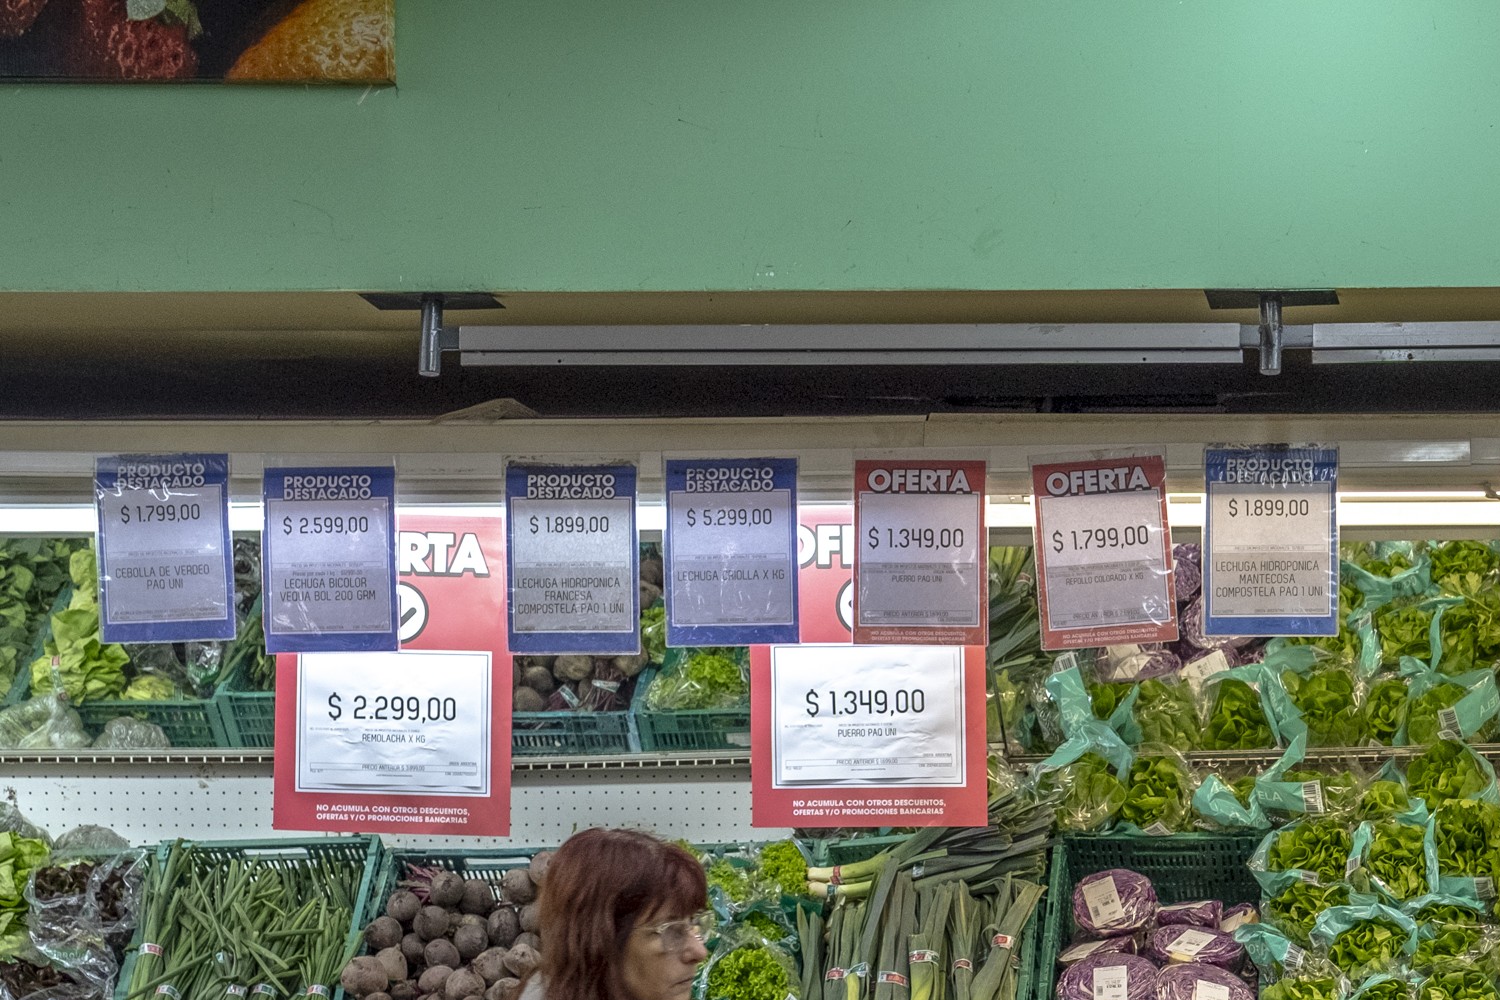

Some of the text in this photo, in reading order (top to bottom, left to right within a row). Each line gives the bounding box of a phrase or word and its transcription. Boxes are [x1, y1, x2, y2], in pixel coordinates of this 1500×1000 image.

[117, 463, 205, 477] PRODUCTO
[1226, 458, 1314, 471] PRODUCTO
[527, 474, 616, 488] PRODUCTO
[686, 467, 774, 481] PRODUCTO
[867, 468, 973, 494] OFERTA
[1226, 470, 1314, 484] DESTACADO
[117, 475, 205, 490] DESTACADO
[283, 475, 372, 489] PRODUCTO
[686, 479, 774, 493] DESTACADO
[1046, 466, 1152, 497] OFERTA
[283, 487, 372, 500] DESTACADO
[527, 486, 616, 500] DESTACADO
[120, 503, 200, 524] $ 1.799,00
[1228, 498, 1309, 518] $ 1.899,00
[530, 515, 609, 534] $ 1.899,00
[686, 507, 772, 528] $ 5.299,00
[283, 516, 369, 536] $ 2.599,00
[868, 526, 879, 549] $
[887, 528, 964, 550] 1.349,00
[1052, 525, 1149, 553] $ 1.799,00
[399, 531, 490, 577] RTA
[115, 564, 210, 579] CEBOLLA DE VERDEO
[1215, 560, 1319, 572] LECHUGA HIDROPONICA
[677, 569, 785, 581] LECHUGA CRIOLLA X KG
[891, 575, 916, 583] PUERRO
[1065, 576, 1093, 586] REPOLLO
[1094, 573, 1127, 584] COLORADO
[1239, 574, 1296, 584] MANTECOSA
[168, 578, 184, 589] UNI
[284, 577, 367, 589] LECHUGA BICOLOR
[517, 577, 620, 589] LECHUGA HIDROPONICA
[314, 590, 332, 601] BOL
[335, 590, 353, 601] 200
[357, 590, 376, 600] GRM
[544, 590, 593, 601] FRANCESA
[1215, 586, 1276, 598] COMPOSTELA
[1279, 586, 1298, 597] PAQ
[1308, 586, 1324, 597] UNI
[518, 603, 577, 614] COMPOSTELA
[609, 603, 624, 613] UNI
[328, 692, 456, 723] $ 2.299,00
[806, 689, 925, 717] $ 1.349,00
[362, 733, 426, 744] REMOLACHA X KG
[838, 727, 897, 738] PUERRO PAQ UNI
[316, 804, 470, 816] NO ACUMULA CON OTROS DESCUENTOS,
[806, 799, 844, 807] ACUMULA
[846, 799, 865, 807] CON
[866, 799, 893, 807] OTROS
[894, 799, 947, 807] DESCUENTOS,
[316, 813, 468, 824] OFERTAS Y/O PROMOCIONES BANCARIAS
[793, 808, 824, 816] OFERTAS
[825, 808, 841, 816] Y/O
[899, 807, 944, 815] BANCARIAS
